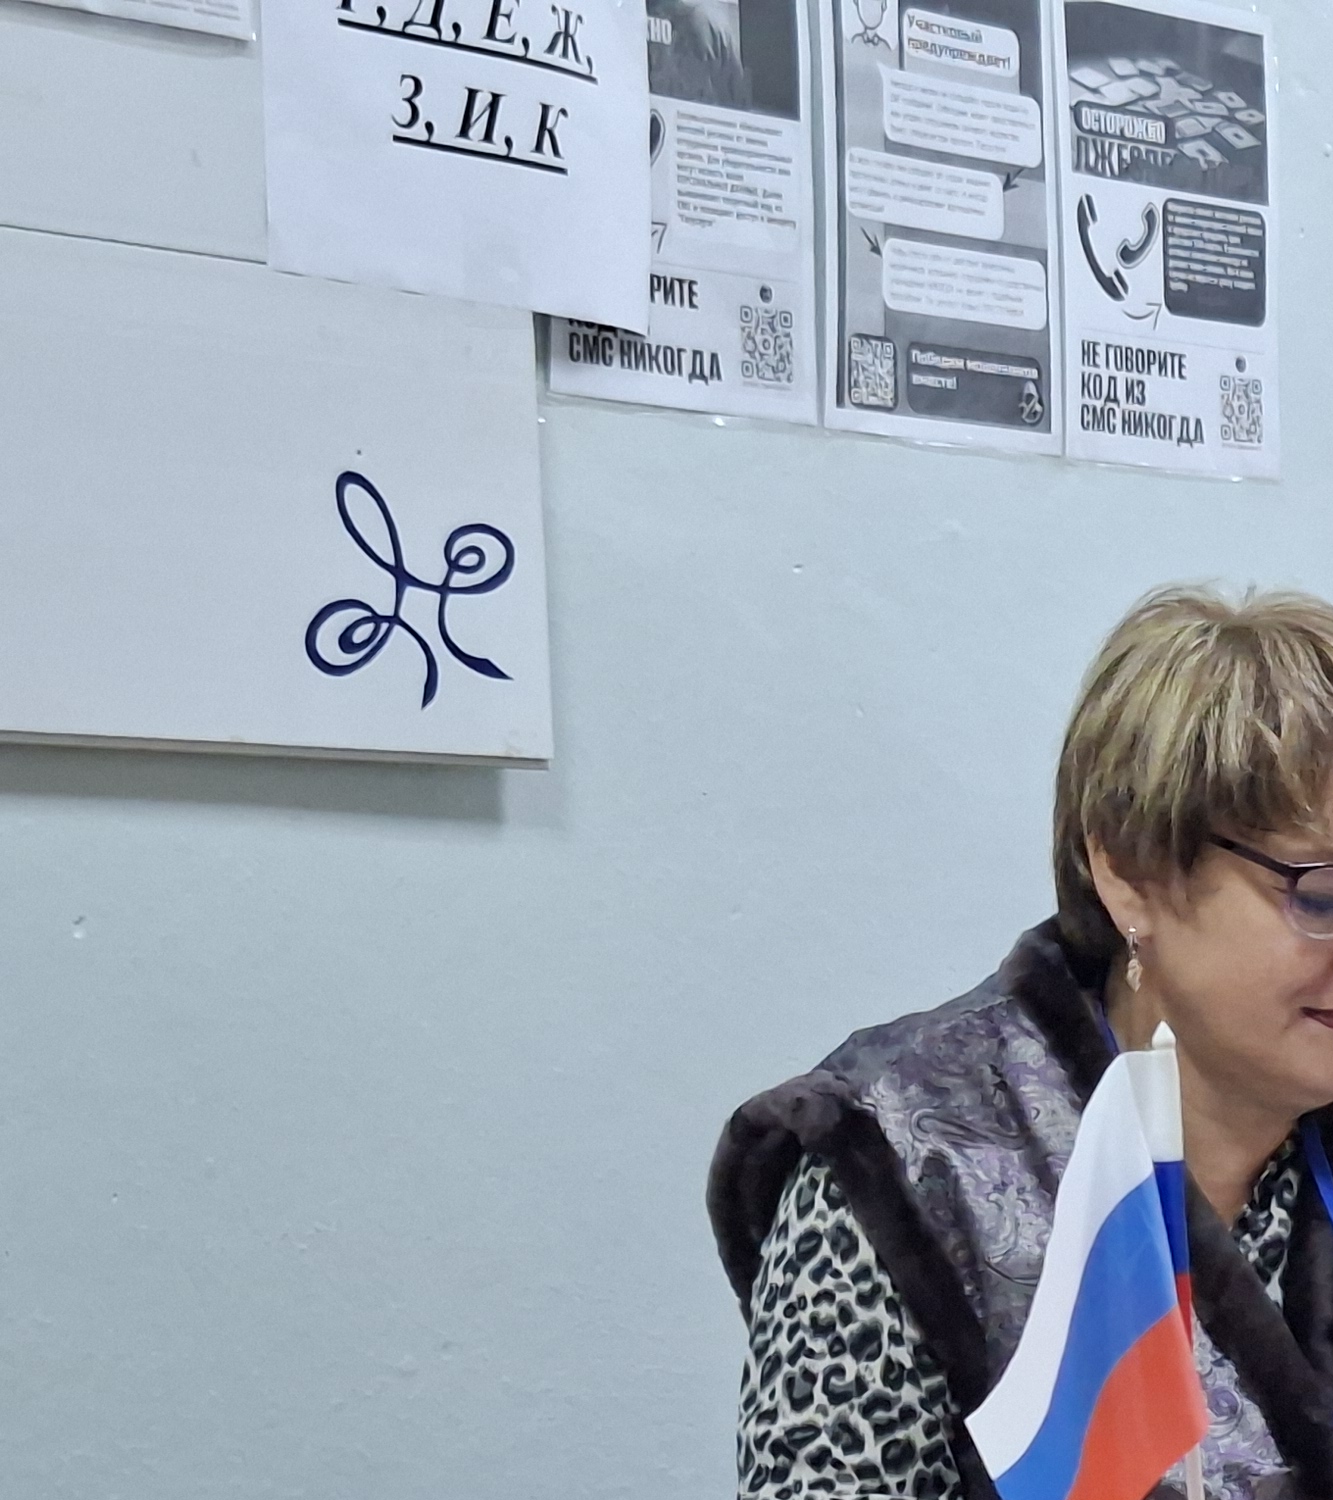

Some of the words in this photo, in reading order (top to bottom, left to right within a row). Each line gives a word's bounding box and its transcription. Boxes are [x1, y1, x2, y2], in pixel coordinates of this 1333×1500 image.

[650, 273, 699, 309] РИТЕ
[568, 332, 614, 366] СМС
[619, 336, 723, 385] НИКОГДА
[1081, 340, 1101, 368] НЕ
[1105, 344, 1187, 380] ГОВОРИТЕ
[1081, 372, 1120, 408] КОД
[1125, 377, 1146, 406] ИЗ
[1080, 404, 1117, 434] СМС
[1121, 409, 1205, 448] НИКОГДА
